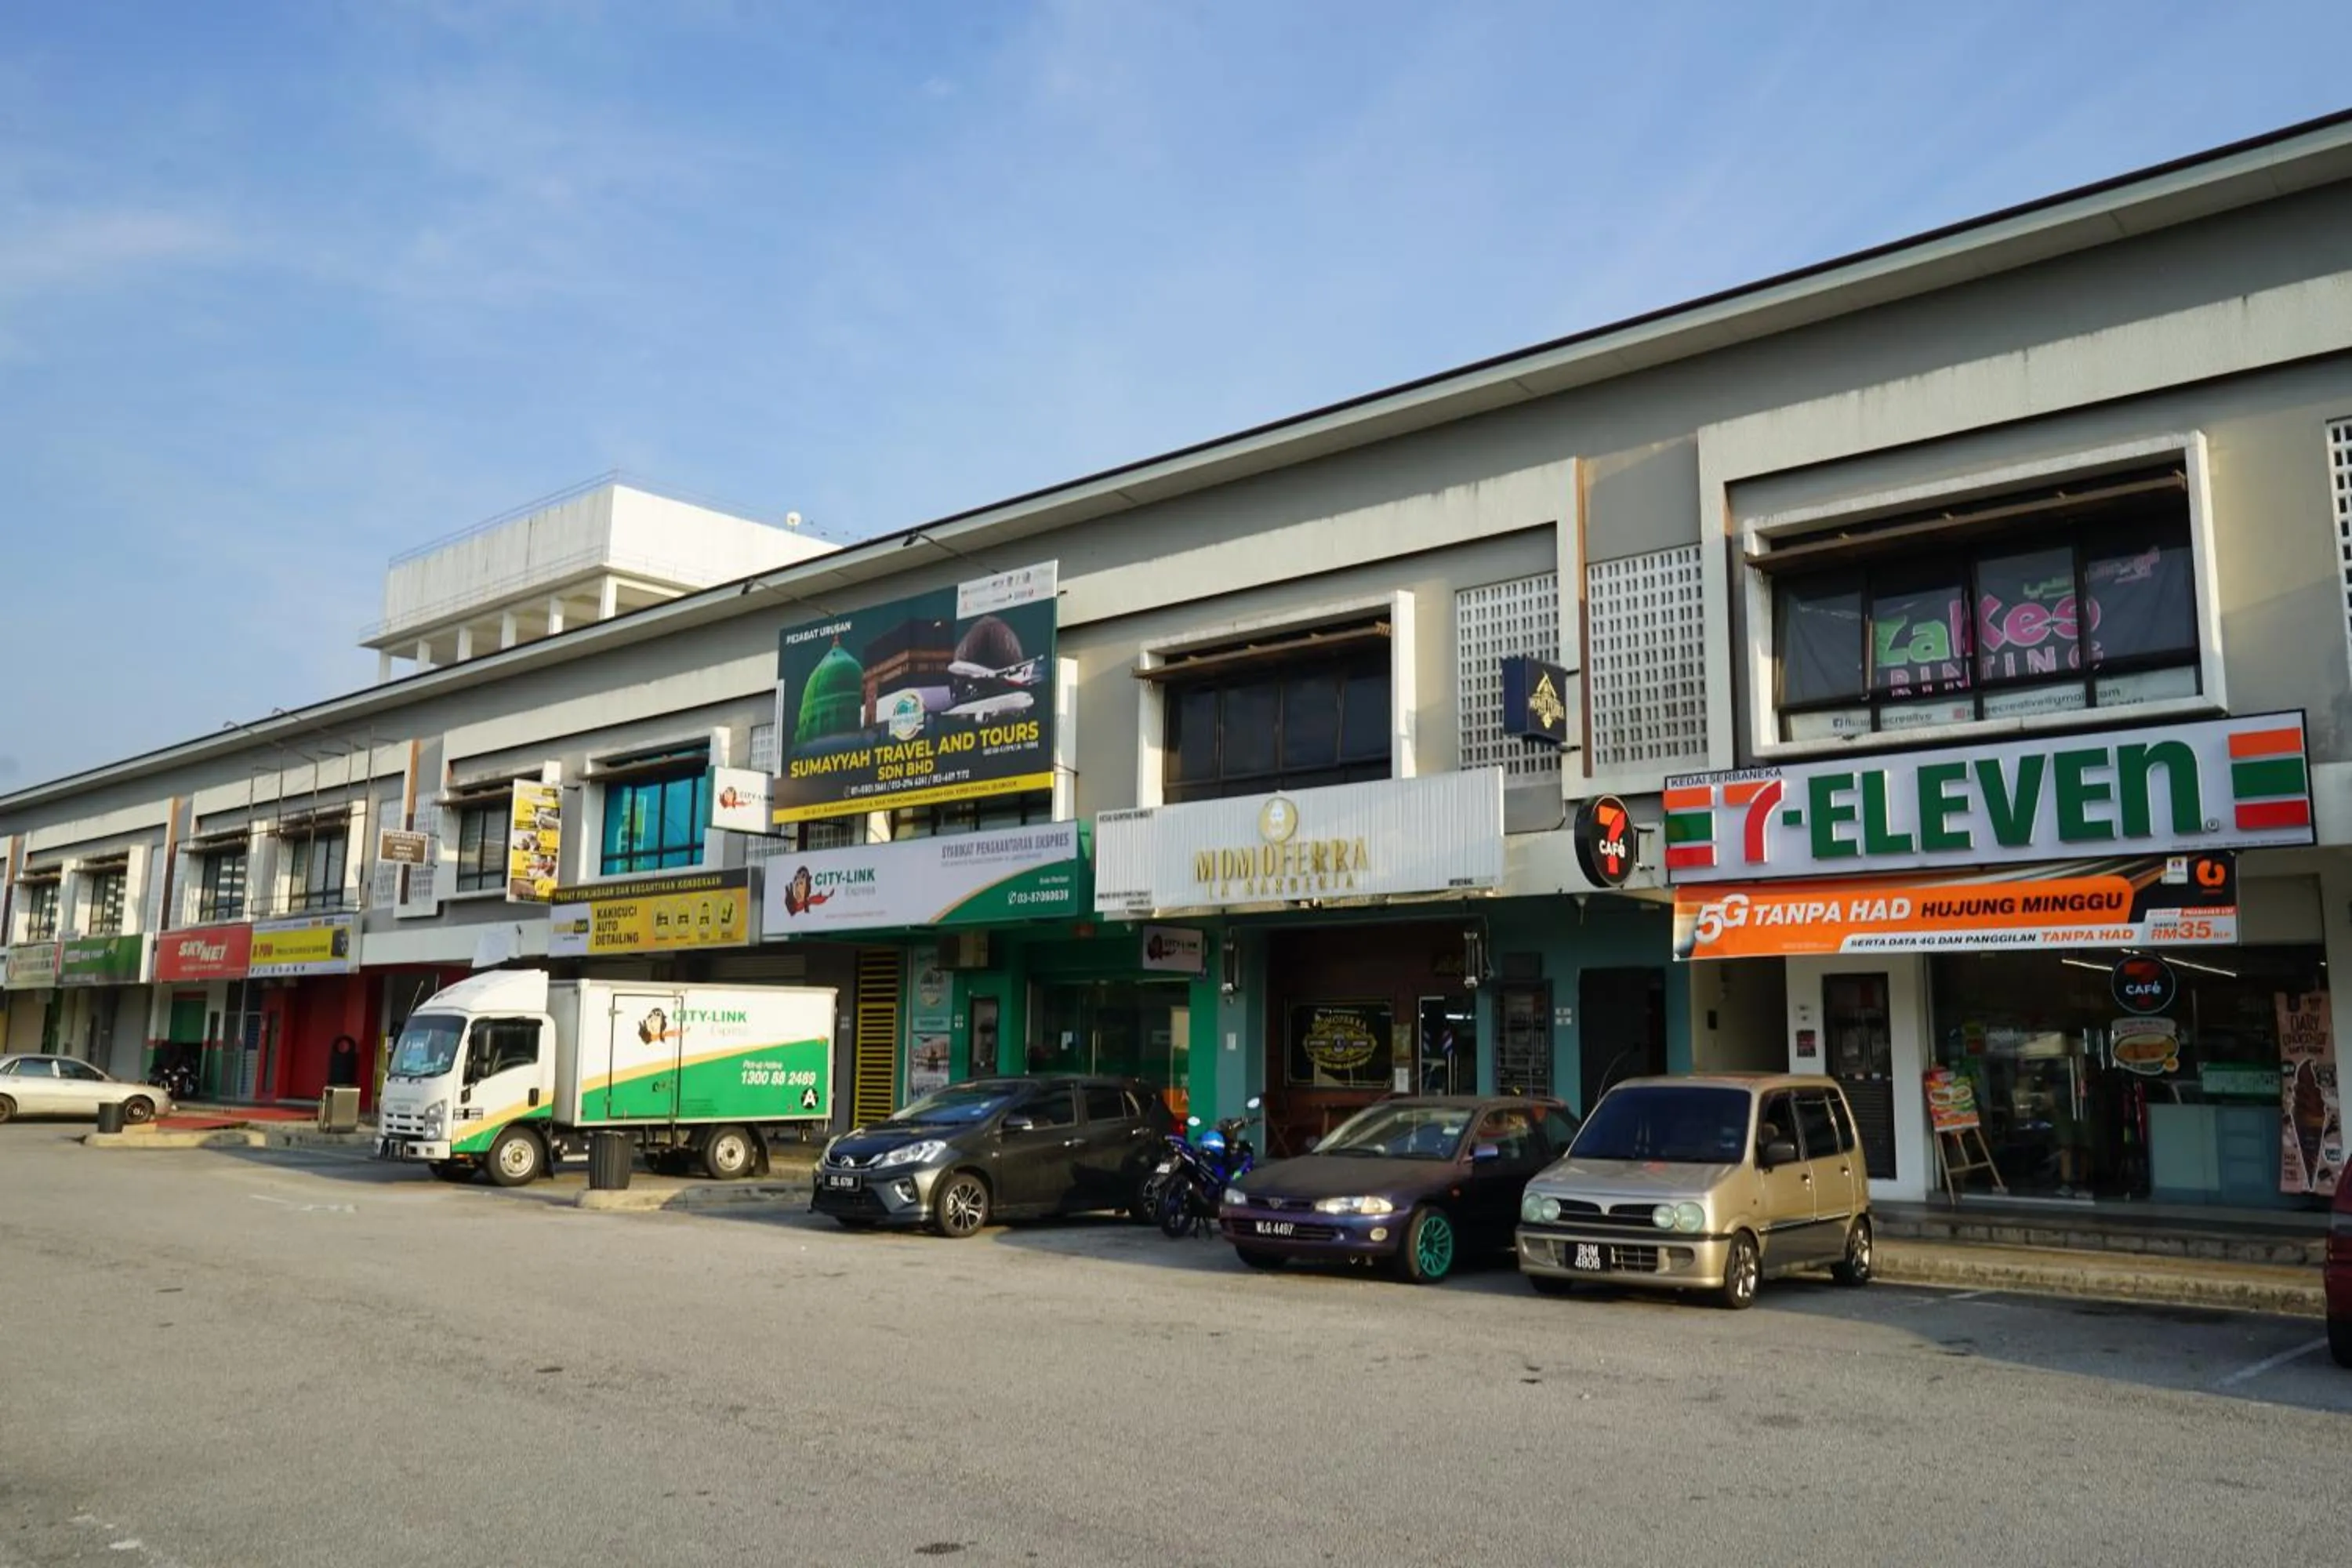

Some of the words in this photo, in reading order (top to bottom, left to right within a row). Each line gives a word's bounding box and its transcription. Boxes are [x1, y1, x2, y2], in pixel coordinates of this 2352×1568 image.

[789, 748, 870, 779] SUMAYYAH
[874, 740, 934, 764] TRAVEL
[938, 732, 975, 754] AND
[978, 720, 1039, 747] TOURS
[877, 765, 904, 781] SDN
[906, 759, 934, 775] BHD
[1671, 776, 1707, 787] KEDAI
[1709, 768, 1782, 784] SERBANEKA
[815, 868, 875, 886] CITY-LINK
[1694, 893, 1750, 942] 5G
[1753, 902, 1842, 926] TANPA
[1849, 898, 1911, 922] HAD
[1921, 898, 2015, 918] HUJUNG
[2021, 891, 2124, 913] MINGGU
[596, 920, 619, 932] AUTO
[1938, 935, 1962, 945] DAN
[1965, 933, 2037, 944] PANGGILAN
[2040, 929, 2096, 942] TANPA
[2098, 927, 2134, 940] HAD
[672, 1010, 747, 1022] CITY-LINK
[741, 1070, 769, 1085] 1300
[802, 1088, 816, 1106] A
